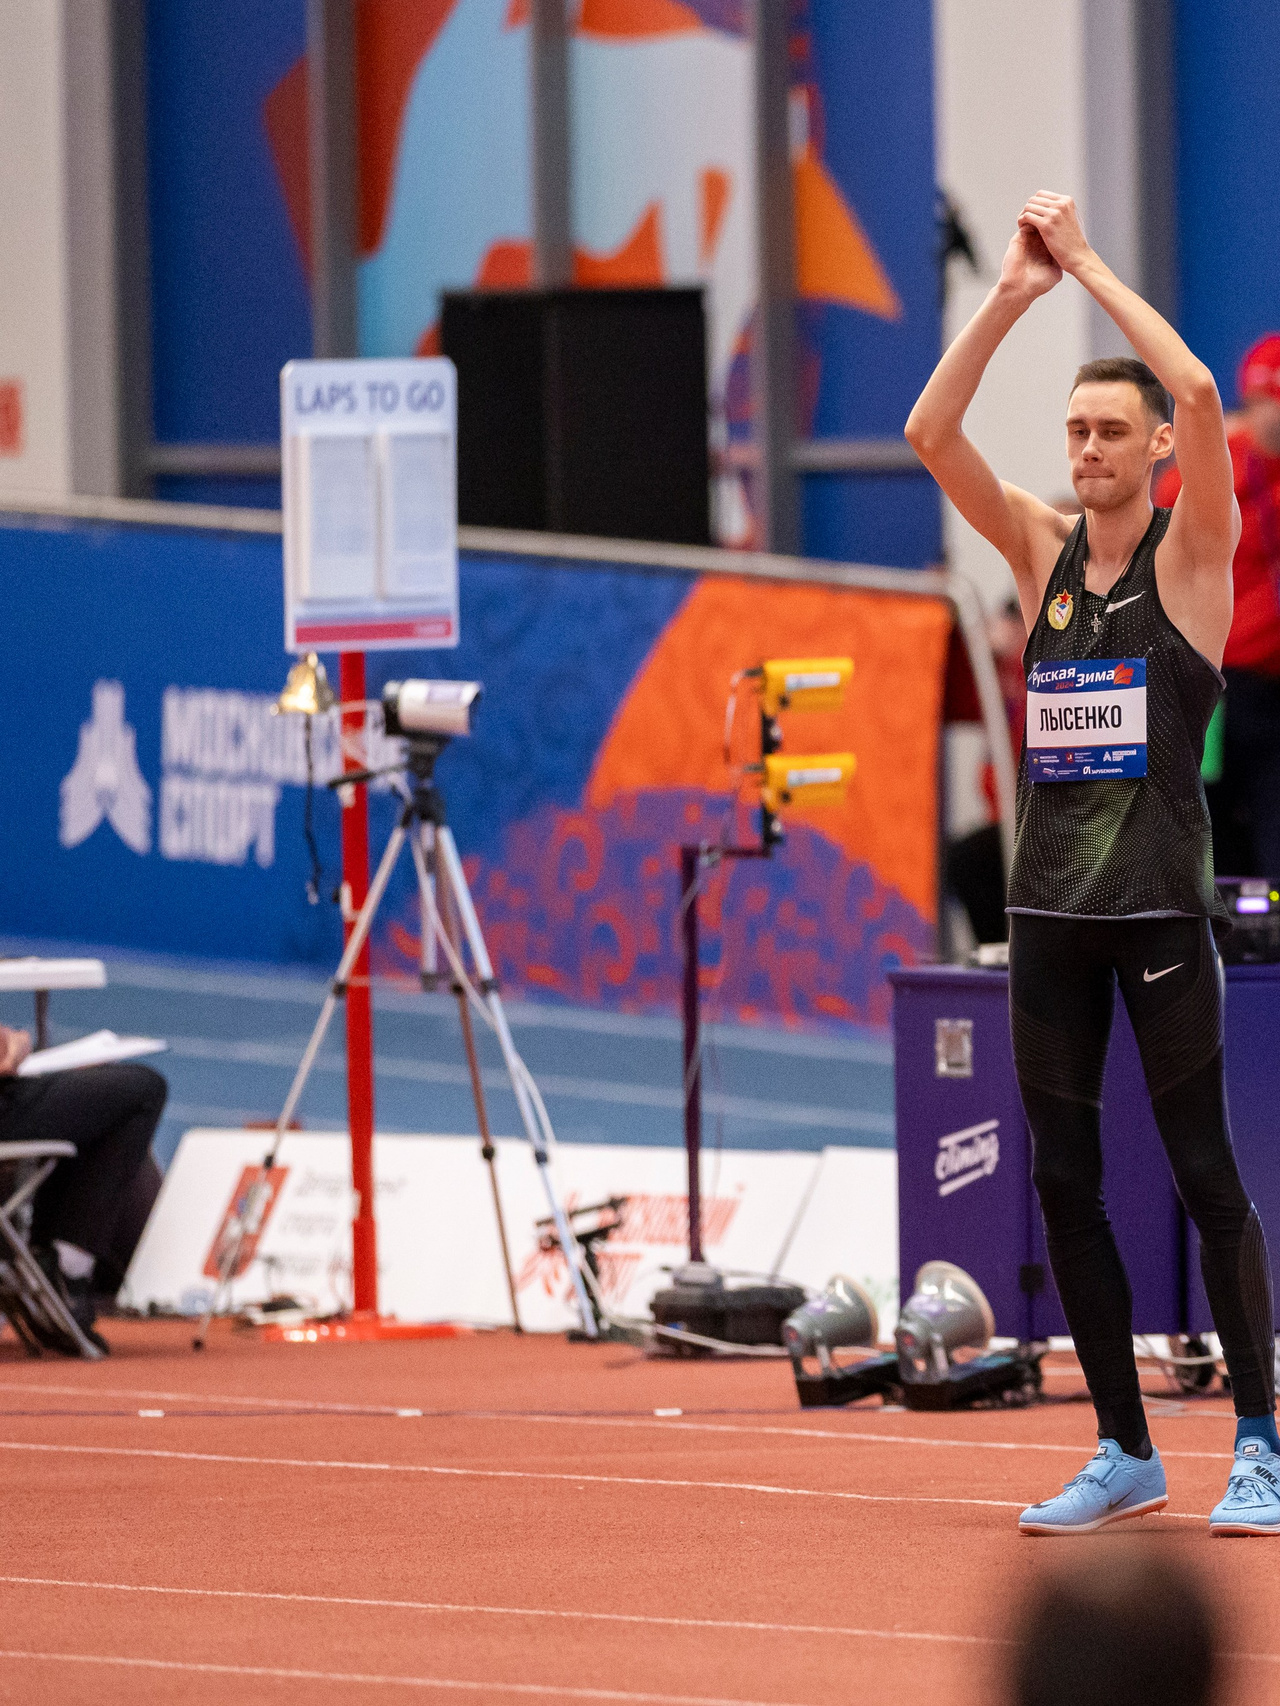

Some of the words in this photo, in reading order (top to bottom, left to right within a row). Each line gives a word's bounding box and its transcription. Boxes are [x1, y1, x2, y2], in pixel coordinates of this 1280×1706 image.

[294, 381, 359, 416] LAPS
[366, 380, 400, 415] TO
[405, 379, 446, 413] GO
[1032, 667, 1077, 688] Русская
[1040, 704, 1123, 732] ЛЫСЕНКО
[1250, 1465, 1280, 1487] NIKE
